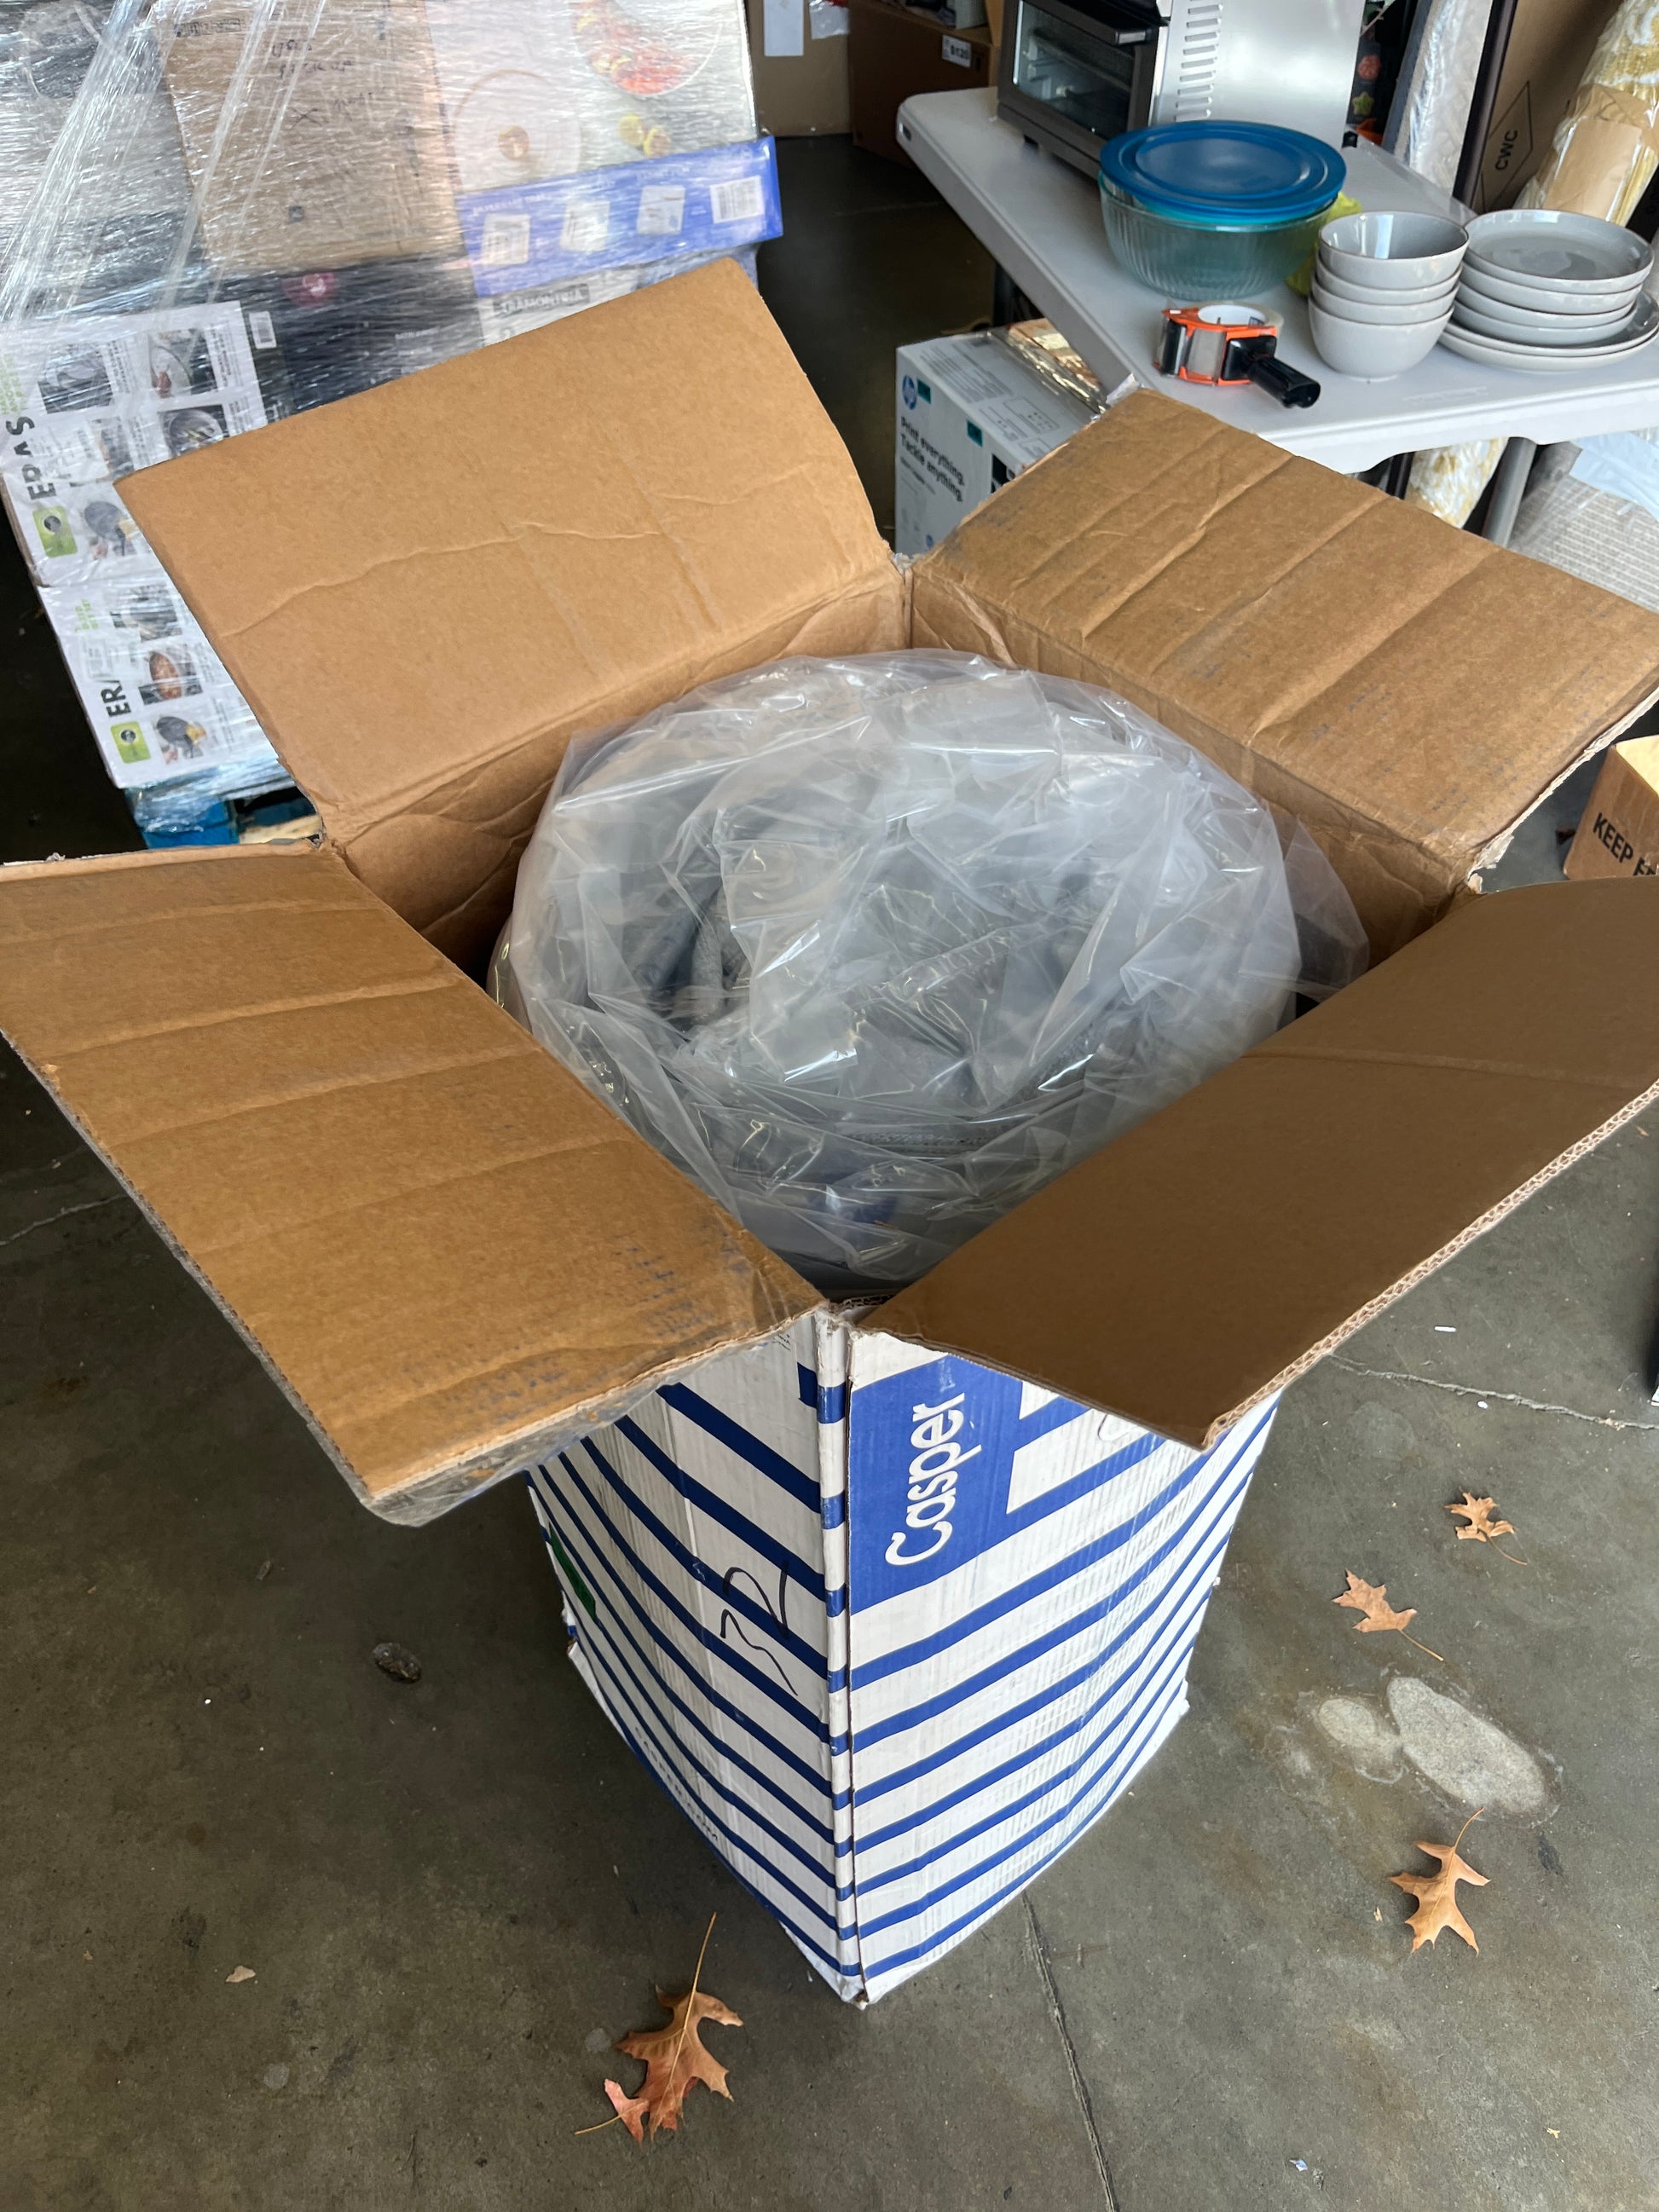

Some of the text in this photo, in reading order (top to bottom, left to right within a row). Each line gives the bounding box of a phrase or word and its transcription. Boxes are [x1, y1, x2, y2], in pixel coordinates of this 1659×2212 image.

[1494, 130, 1518, 170] CWC
[900, 416, 919, 442] Print
[96, 679, 132, 718] ER
[1592, 812, 1633, 863] KEEP
[885, 1393, 982, 1566] Casper
